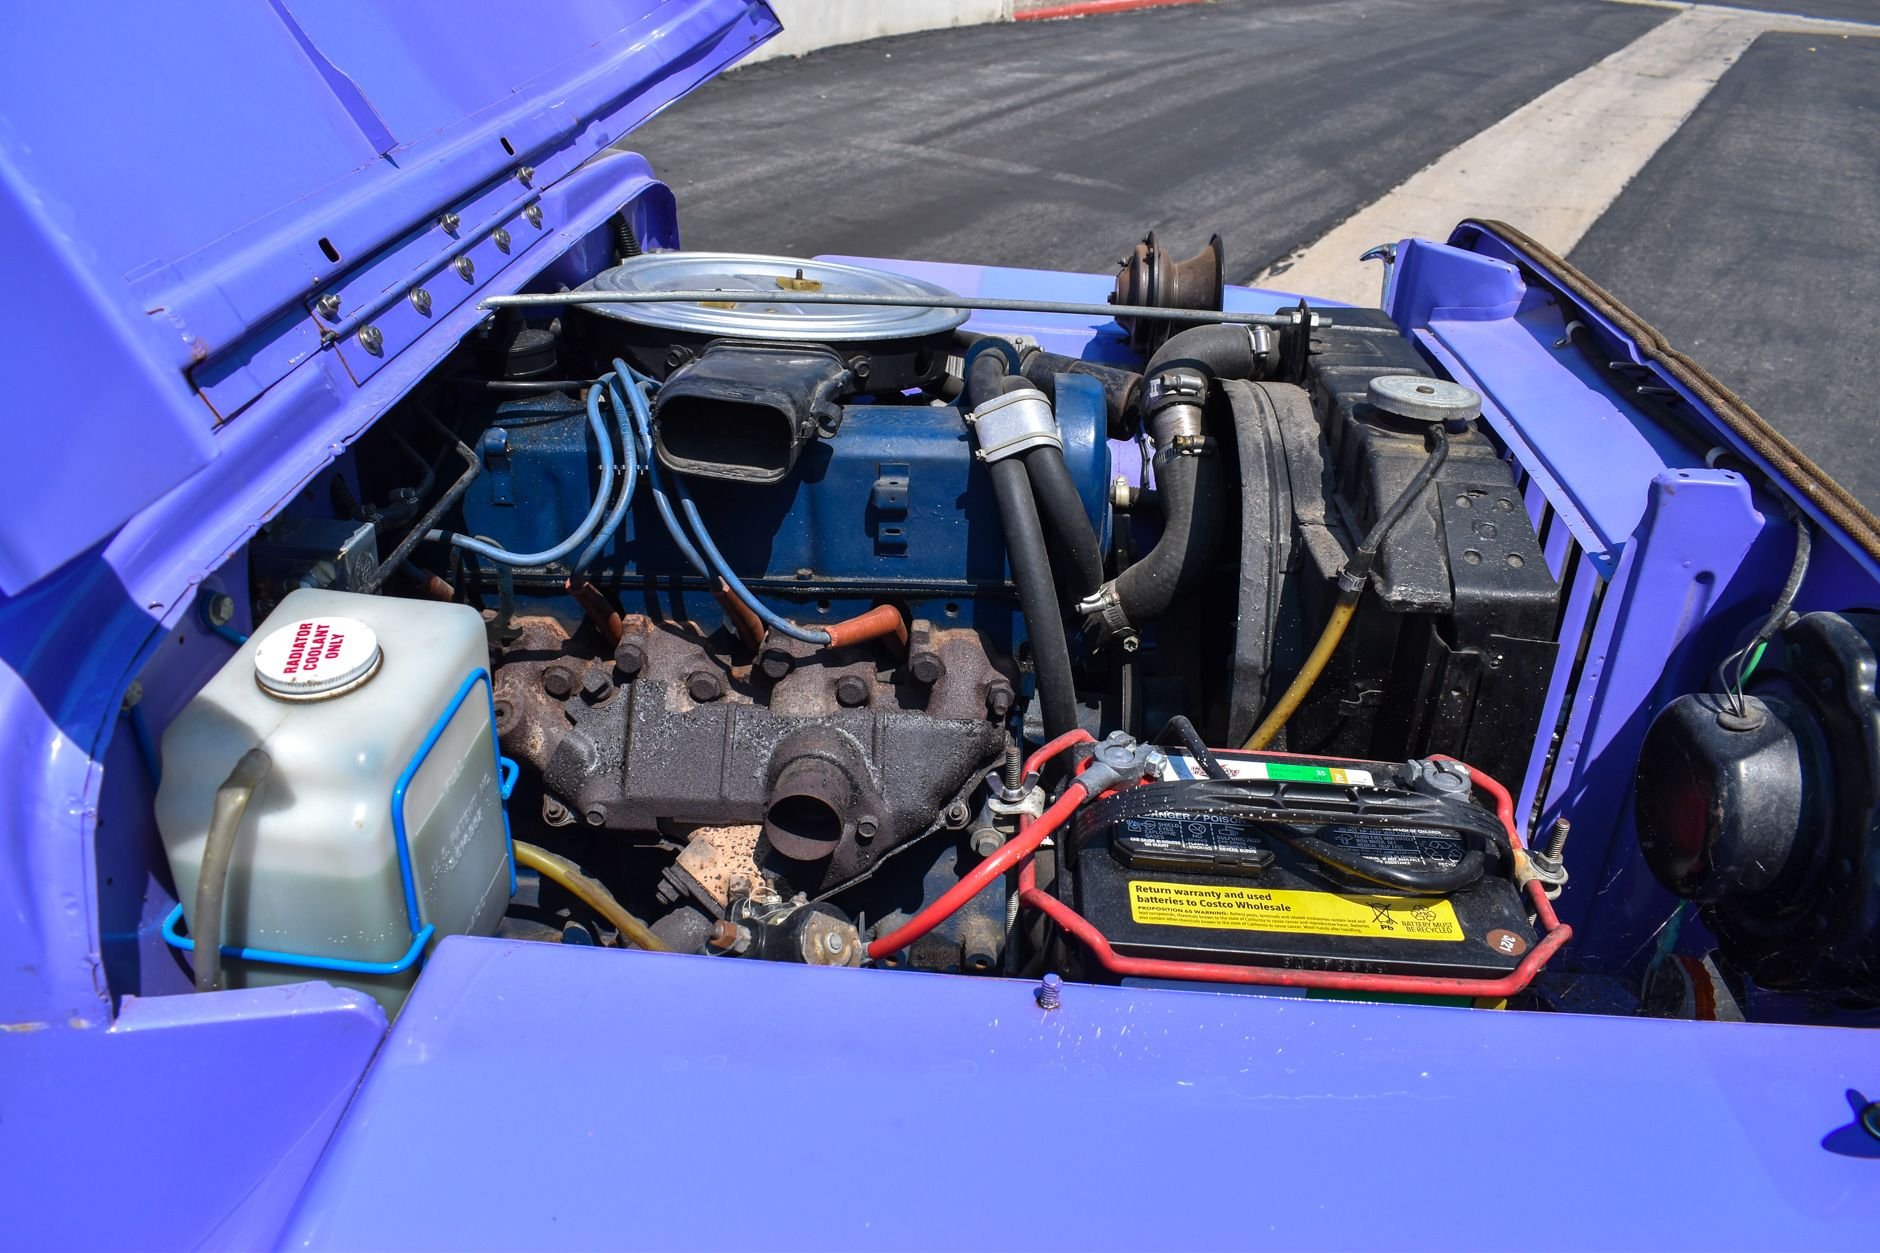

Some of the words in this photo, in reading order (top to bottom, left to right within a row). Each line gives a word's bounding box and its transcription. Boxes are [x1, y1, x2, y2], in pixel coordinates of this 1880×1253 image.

[283, 623, 314, 674] RADIATOR
[302, 624, 330, 670] COOLANT
[325, 634, 344, 658] ONLY
[1136, 886, 1171, 894] Return
[1174, 888, 1221, 900] warranty
[1224, 891, 1244, 899] and
[1137, 895, 1184, 906] batteries
[1200, 900, 1234, 908] Costco
[1235, 902, 1292, 912] Wholesale
[1500, 934, 1516, 952] 3/21
